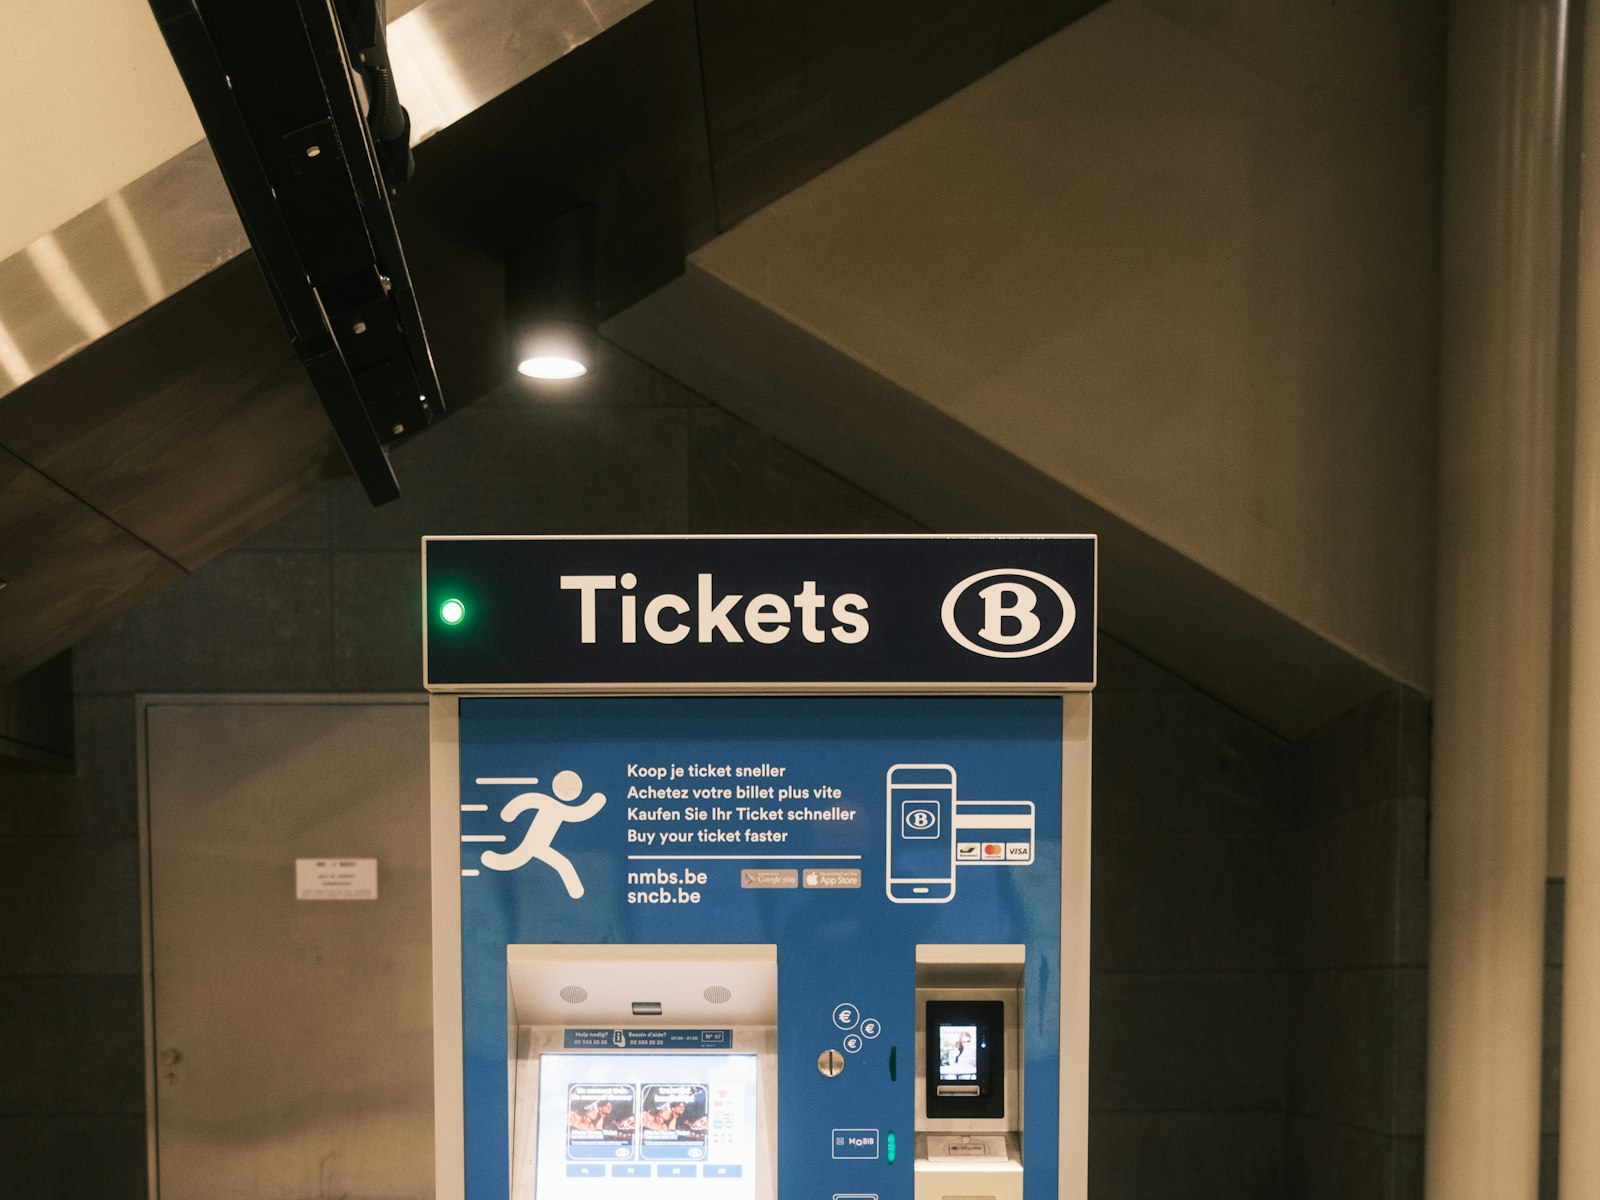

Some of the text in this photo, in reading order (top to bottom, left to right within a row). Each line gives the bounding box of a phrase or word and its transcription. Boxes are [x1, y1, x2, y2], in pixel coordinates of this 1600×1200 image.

[560, 572, 870, 645] Tickets
[627, 763, 786, 780] Koop je ticket sneller
[627, 785, 842, 802] Achetez votre billet plus vite
[627, 806, 857, 821] Kaufen Sie Ihr Ticket schneller
[627, 828, 789, 846] Buy your ticket faster
[627, 867, 708, 886] nmbs.be
[757, 875, 781, 885] Google
[820, 876, 858, 886] App Store
[627, 886, 701, 905] sncb.be
[590, 1031, 609, 1039] nodig?
